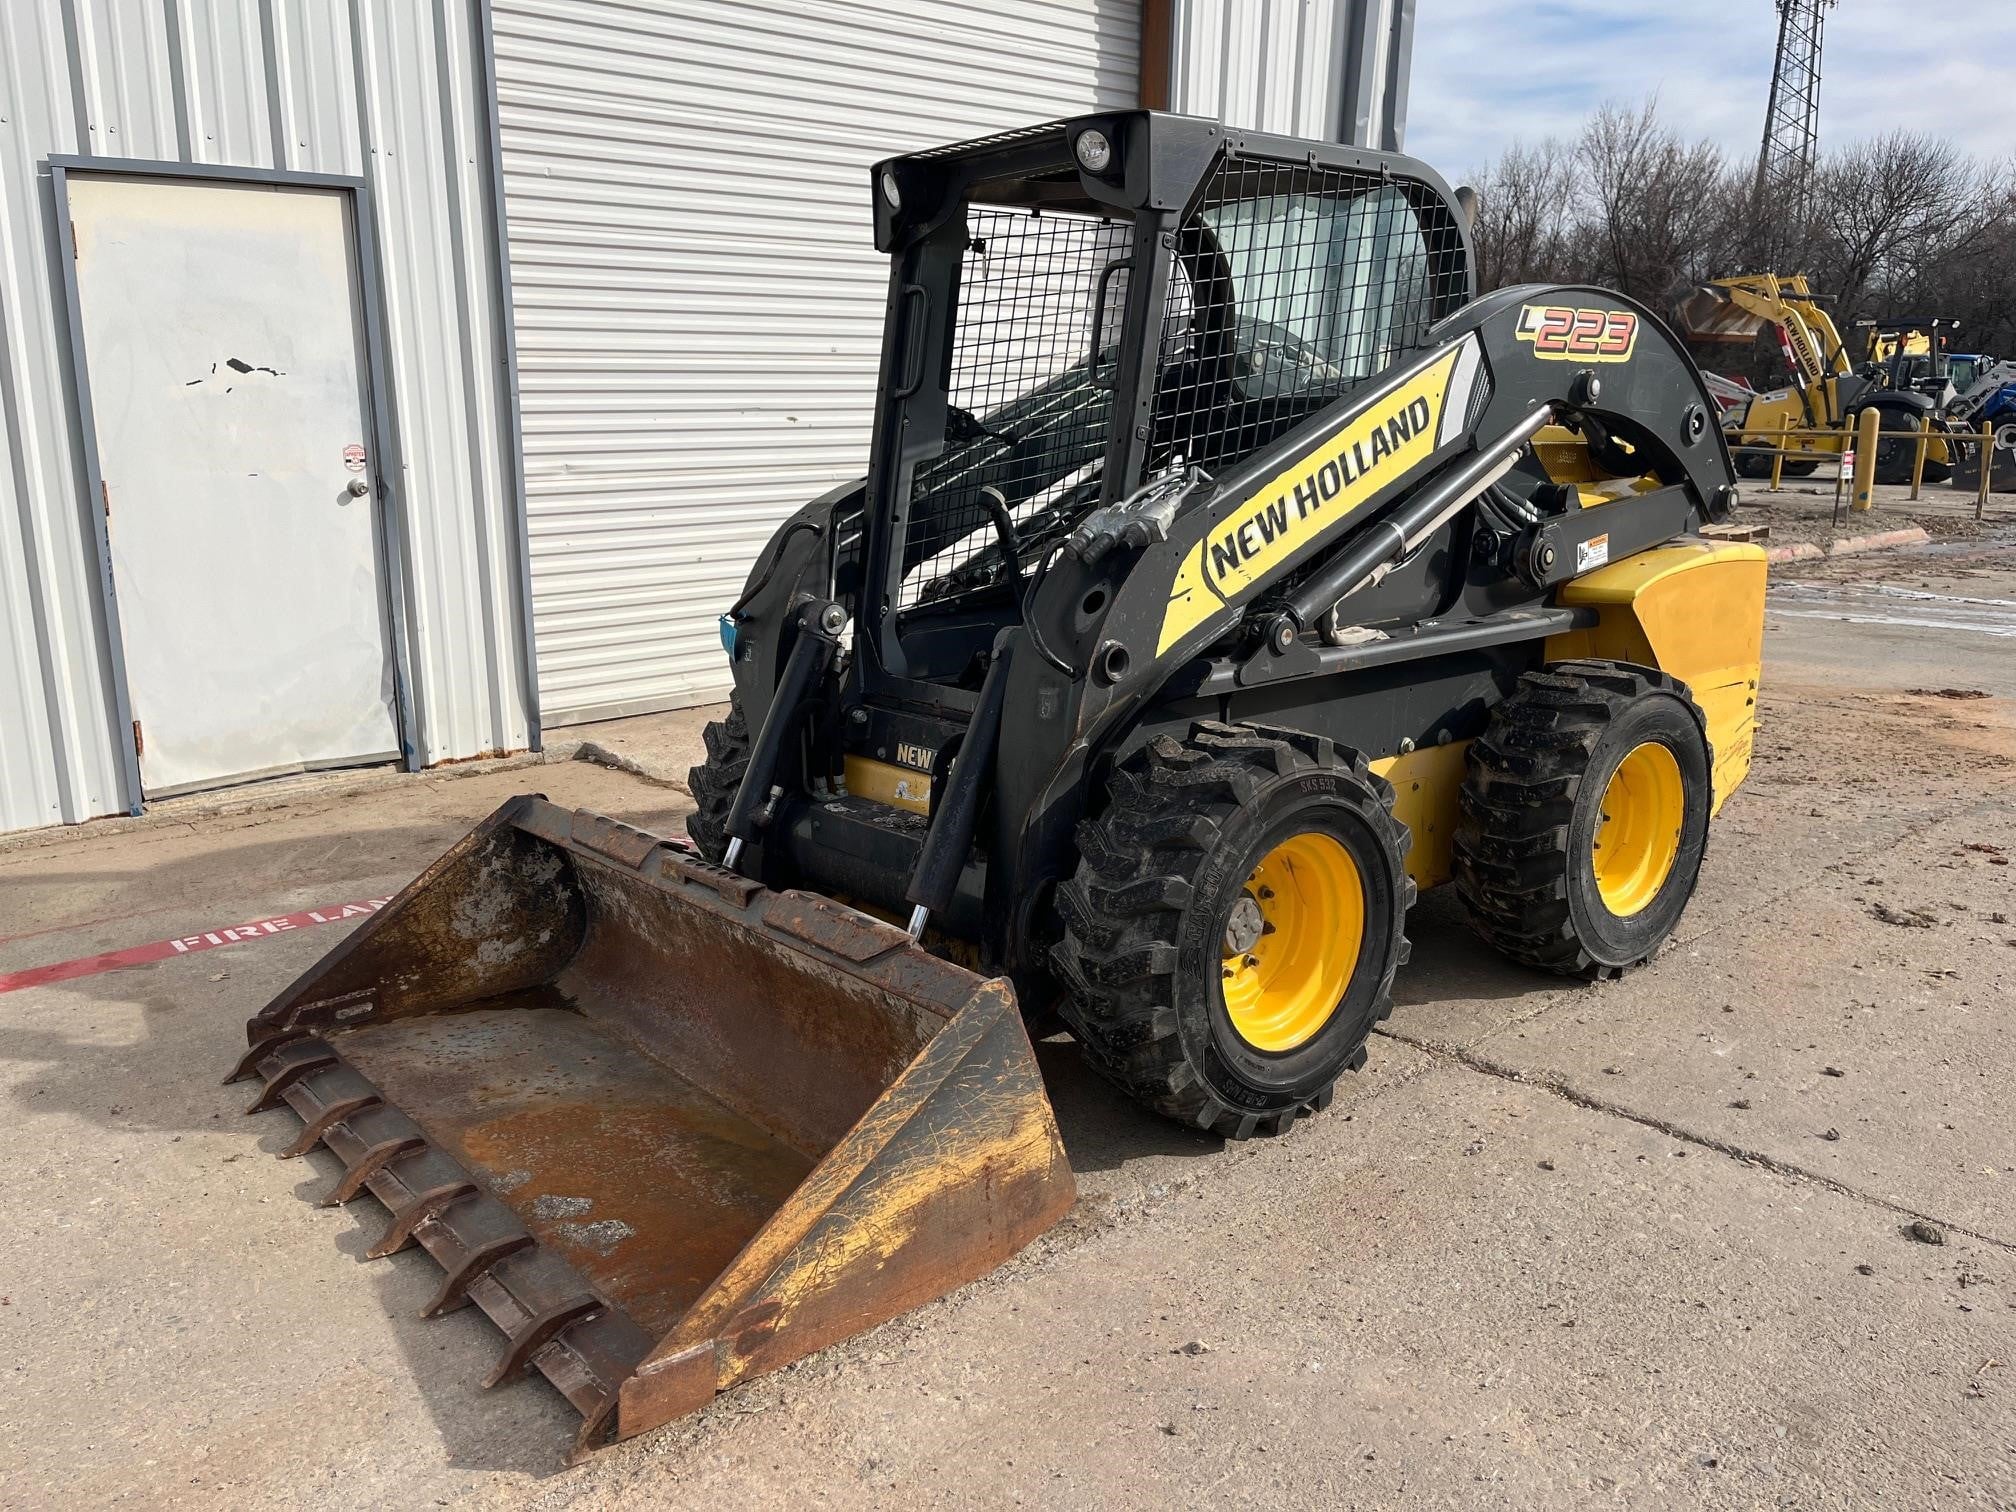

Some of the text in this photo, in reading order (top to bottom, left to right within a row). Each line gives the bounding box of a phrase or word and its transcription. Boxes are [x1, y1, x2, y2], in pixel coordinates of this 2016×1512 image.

[1516, 307, 1637, 356] L223
[1783, 315, 1819, 377] NEW HOLLAND
[1210, 395, 1430, 581] NEW HOLLAND
[896, 743, 932, 769] NEW
[169, 917, 297, 953] FIRE
